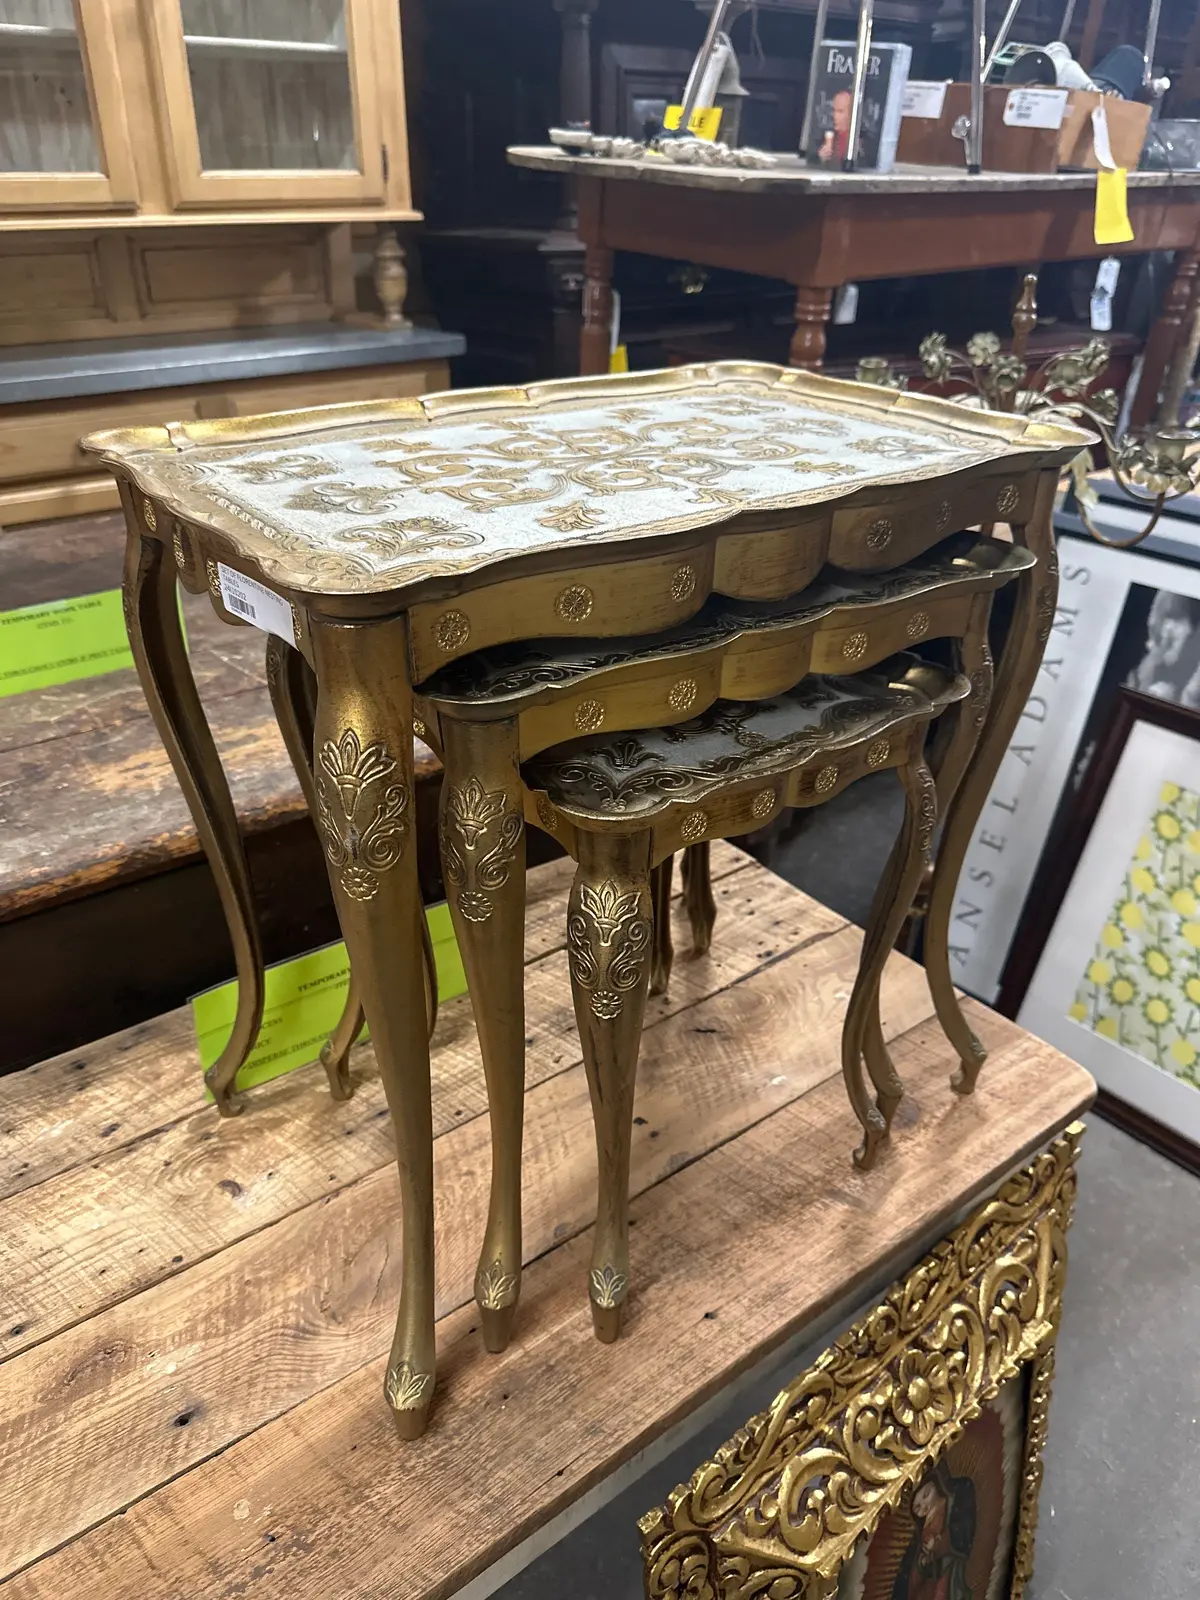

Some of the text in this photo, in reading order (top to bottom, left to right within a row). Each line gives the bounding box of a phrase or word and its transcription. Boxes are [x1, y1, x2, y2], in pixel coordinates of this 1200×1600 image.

[826, 48, 881, 76] FRAR
[948, 563, 1092, 968] ANSEL ADAMS
